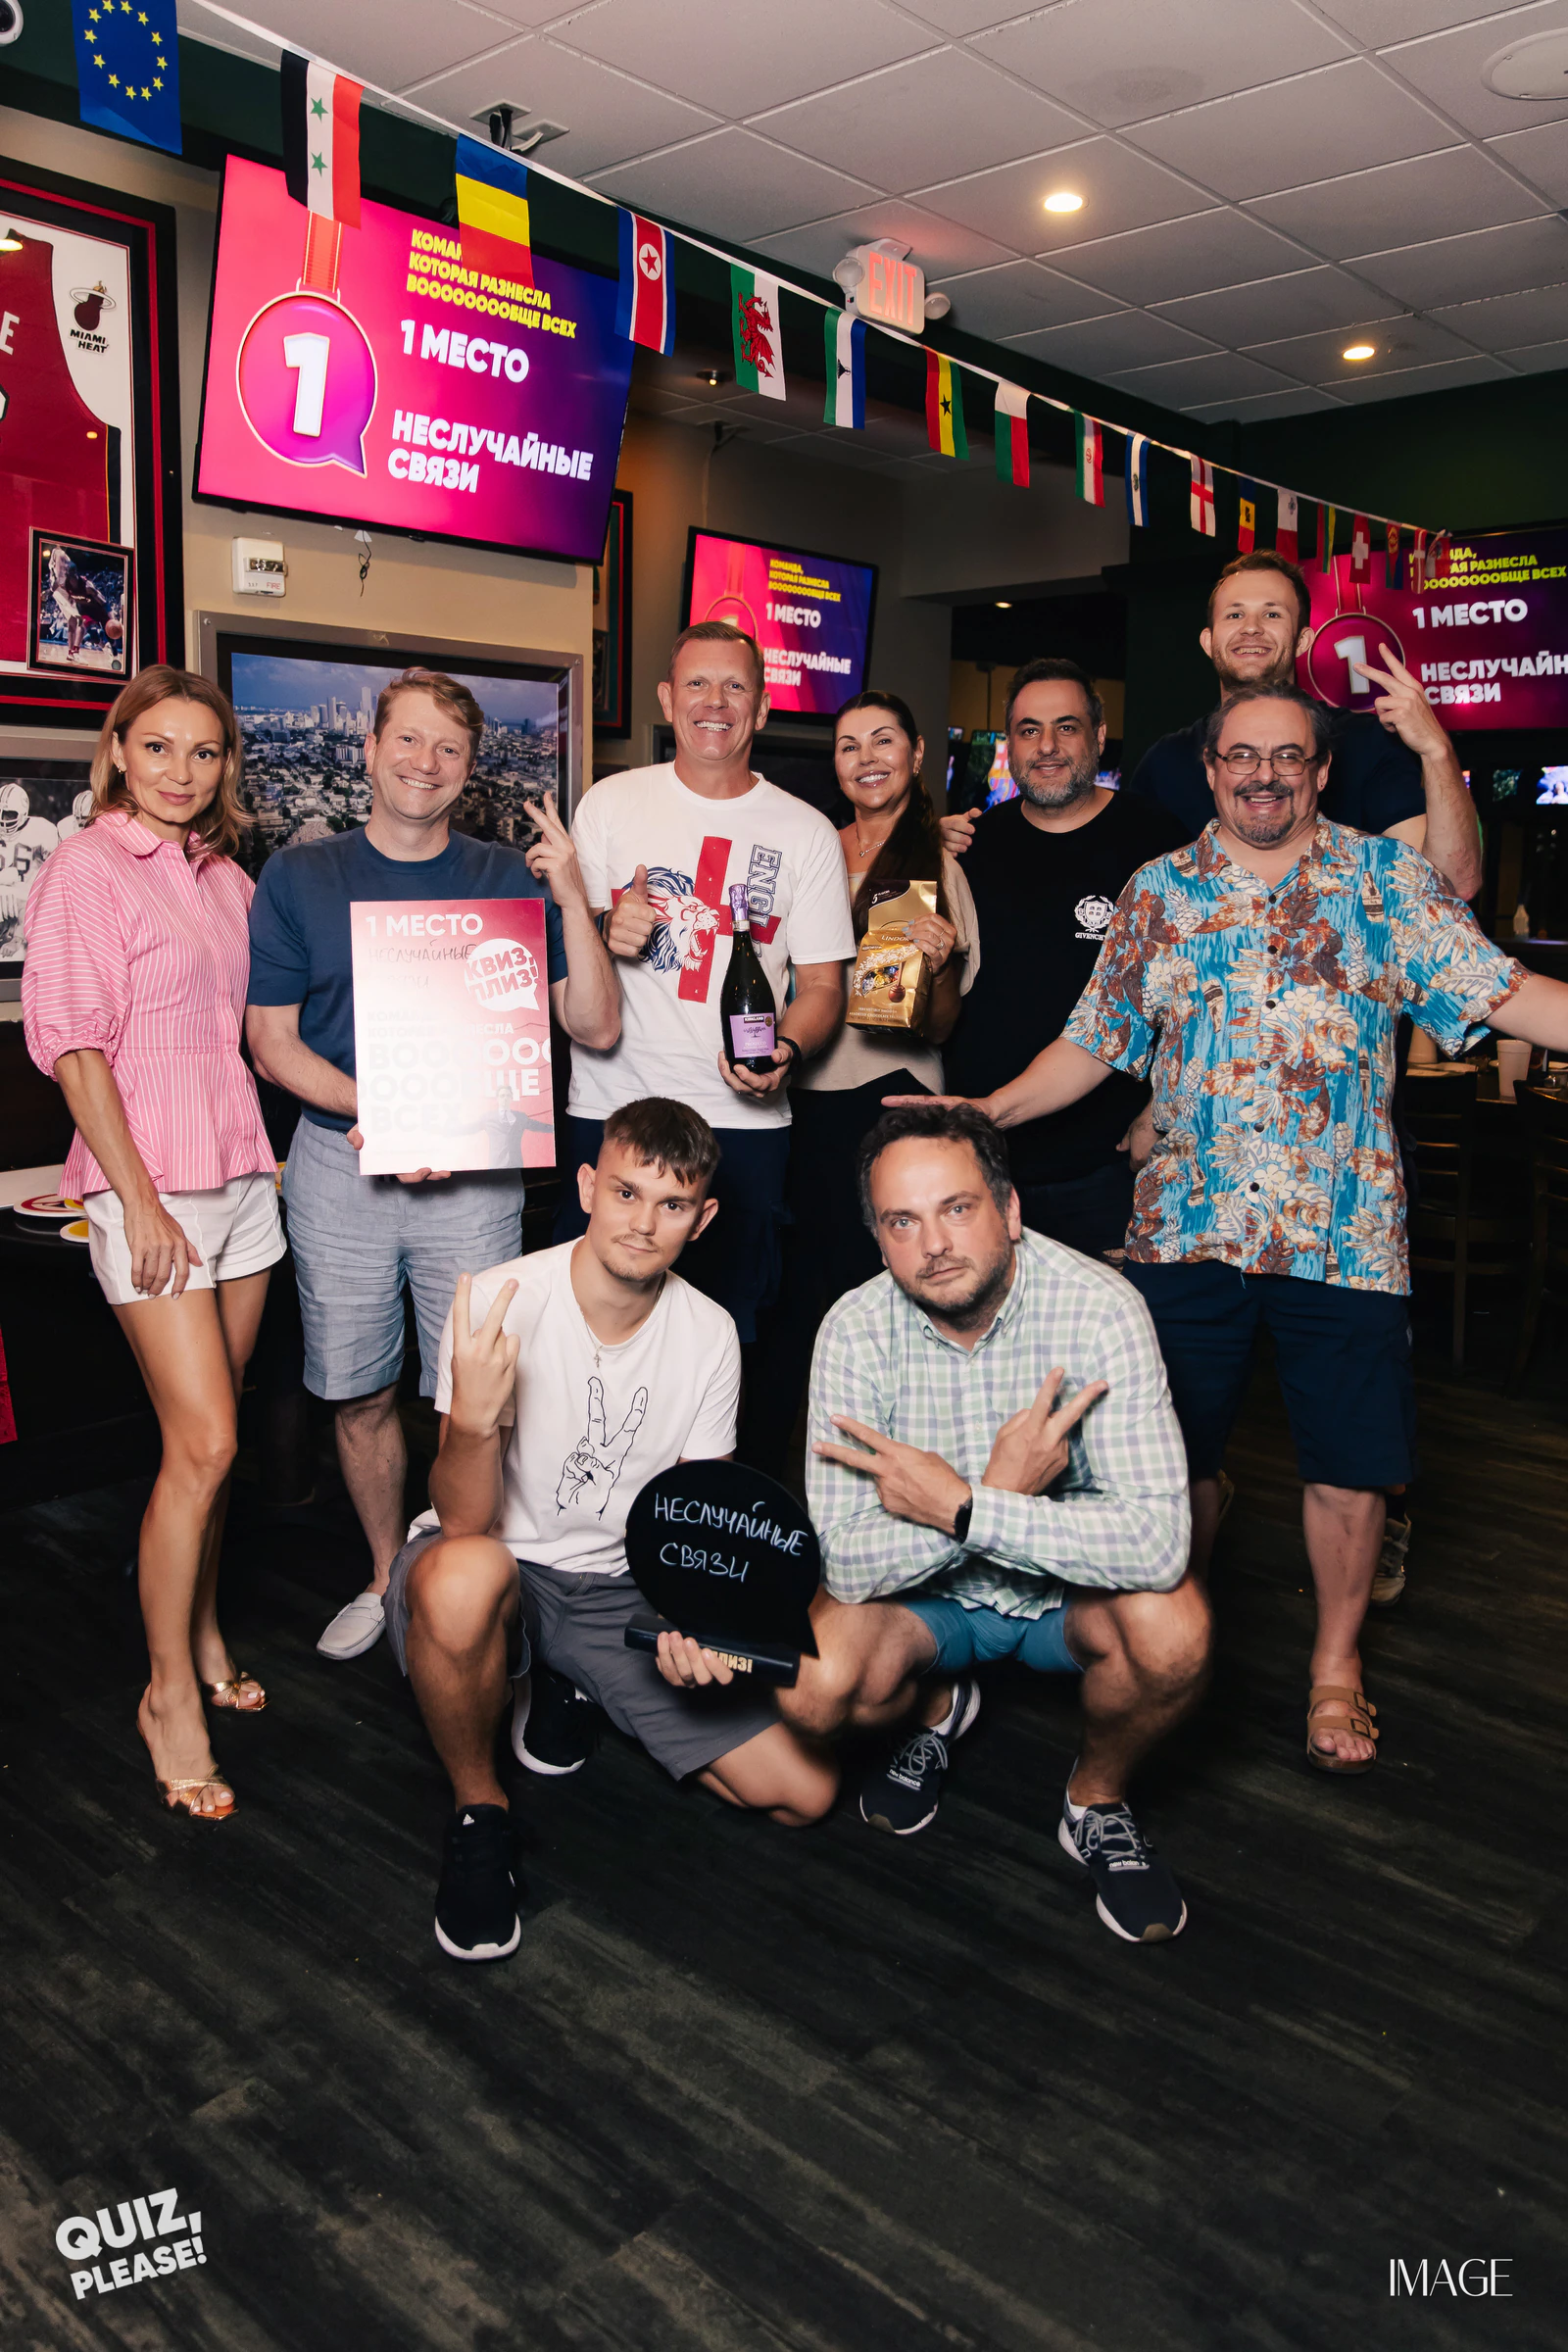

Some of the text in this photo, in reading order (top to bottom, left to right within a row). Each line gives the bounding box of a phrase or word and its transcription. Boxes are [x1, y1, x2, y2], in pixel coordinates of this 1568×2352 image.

[409, 251, 552, 311] КОТОРАЯ РАЗНЕСЛА
[868, 251, 917, 326] EXIT
[407, 273, 577, 339] ВООООООООБЩЕ ВСЕХ
[70, 329, 106, 344] MIAMI
[78, 341, 109, 354] HEAT
[400, 318, 530, 383] 1 МЕСТО
[283, 331, 330, 437] 1
[392, 410, 594, 481] НЕСЛУЧАЙНЫЕ
[388, 448, 480, 493] СВЯЗИ
[1412, 568, 1530, 590] ОООООООБЩЕ
[1532, 565, 1567, 580] ВСЕХ
[1470, 555, 1538, 572] РАЗНЕСЛА
[765, 602, 821, 628] 1 МЕСТО
[1412, 599, 1529, 629] 1 МЕСТО
[763, 648, 852, 674] НЕСЛУЧАЙНЫЕ
[1334, 635, 1370, 695] 1
[763, 667, 802, 687] СВЯЗИ
[1425, 682, 1501, 705] СВЯЗИ
[872, 894, 878, 904] 5
[366, 913, 483, 937] 1 МЕСТО
[655, 1493, 808, 1556] НЕСЛУЧАЙНЫЕ
[660, 1543, 749, 1583] СВЯЗИ
[899, 1774, 921, 1787] balance
